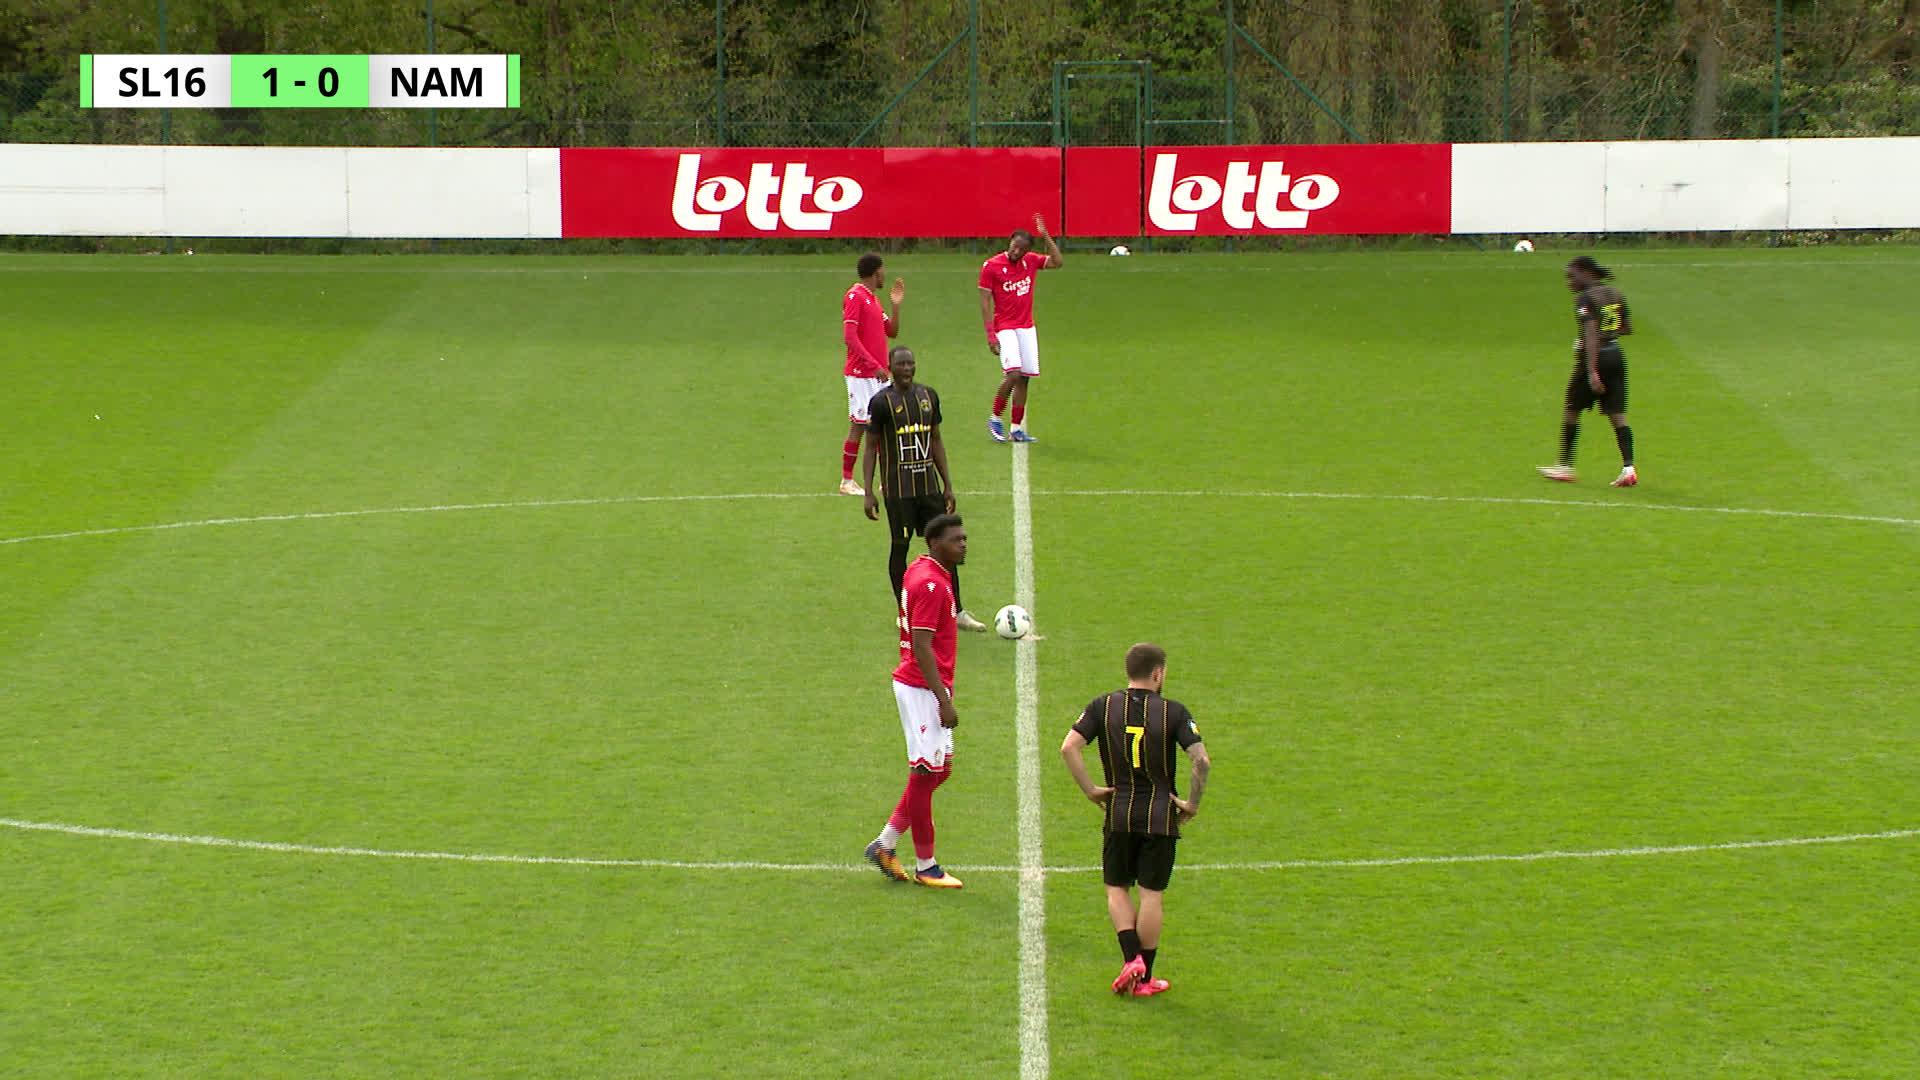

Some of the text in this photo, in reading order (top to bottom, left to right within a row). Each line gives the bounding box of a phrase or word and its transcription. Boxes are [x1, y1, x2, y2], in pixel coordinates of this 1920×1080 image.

[672, 154, 863, 231] lotto
[1147, 154, 1340, 231] lotto
[1126, 726, 1145, 768] 7
